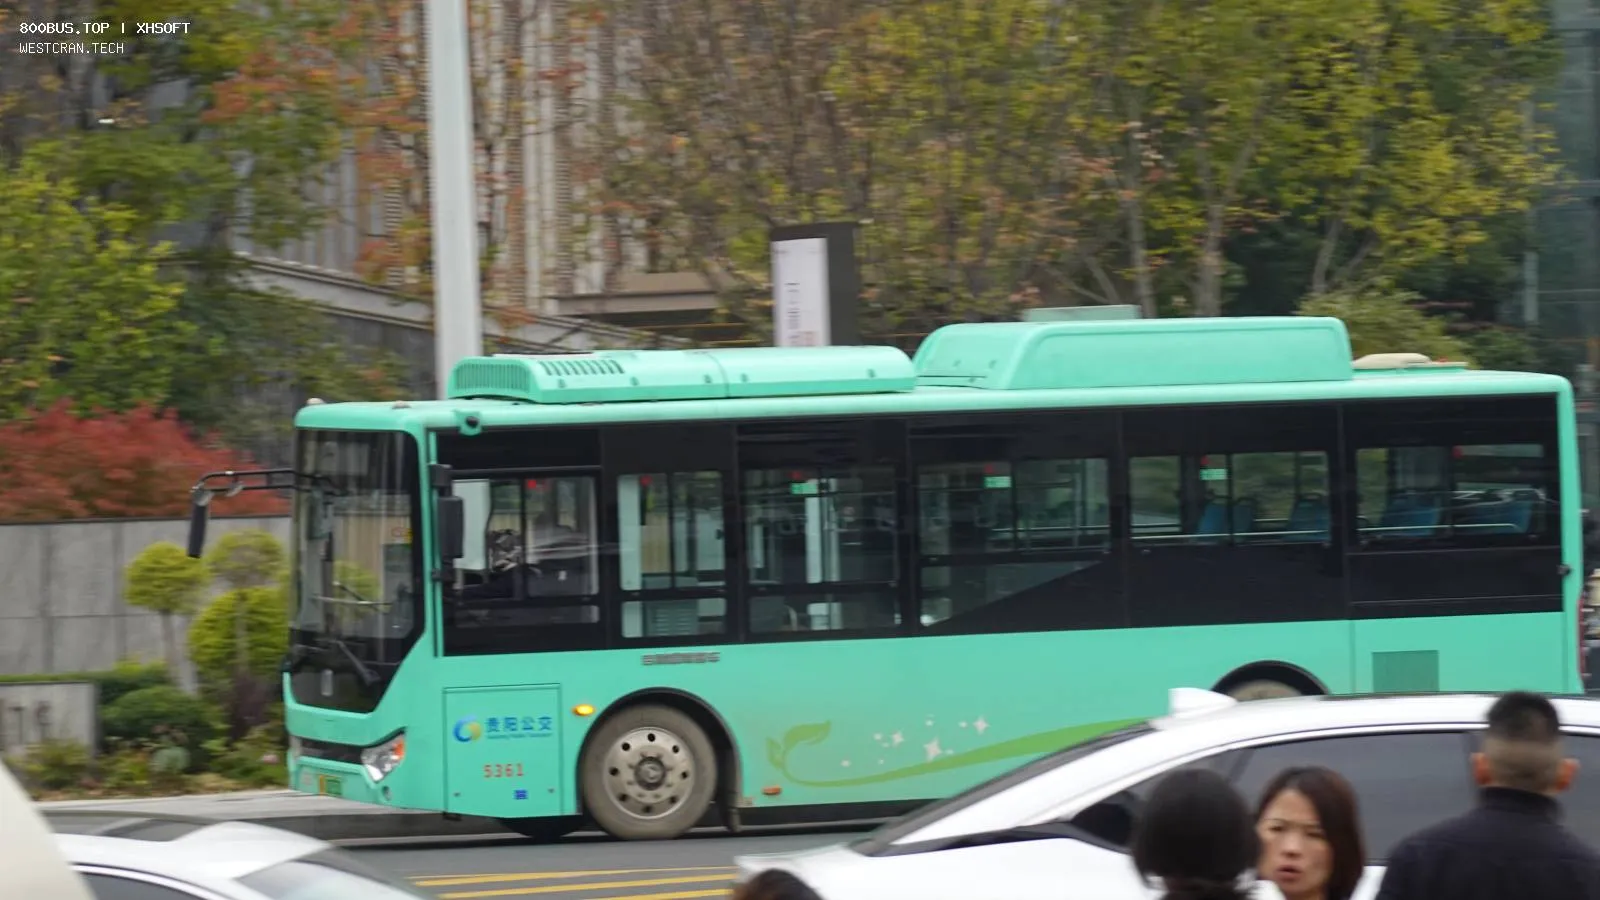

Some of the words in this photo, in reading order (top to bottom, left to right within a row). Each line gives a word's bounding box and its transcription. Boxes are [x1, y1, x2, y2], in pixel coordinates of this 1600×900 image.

[485, 716, 553, 732] 贵阳公交
[483, 763, 525, 778] 5361
